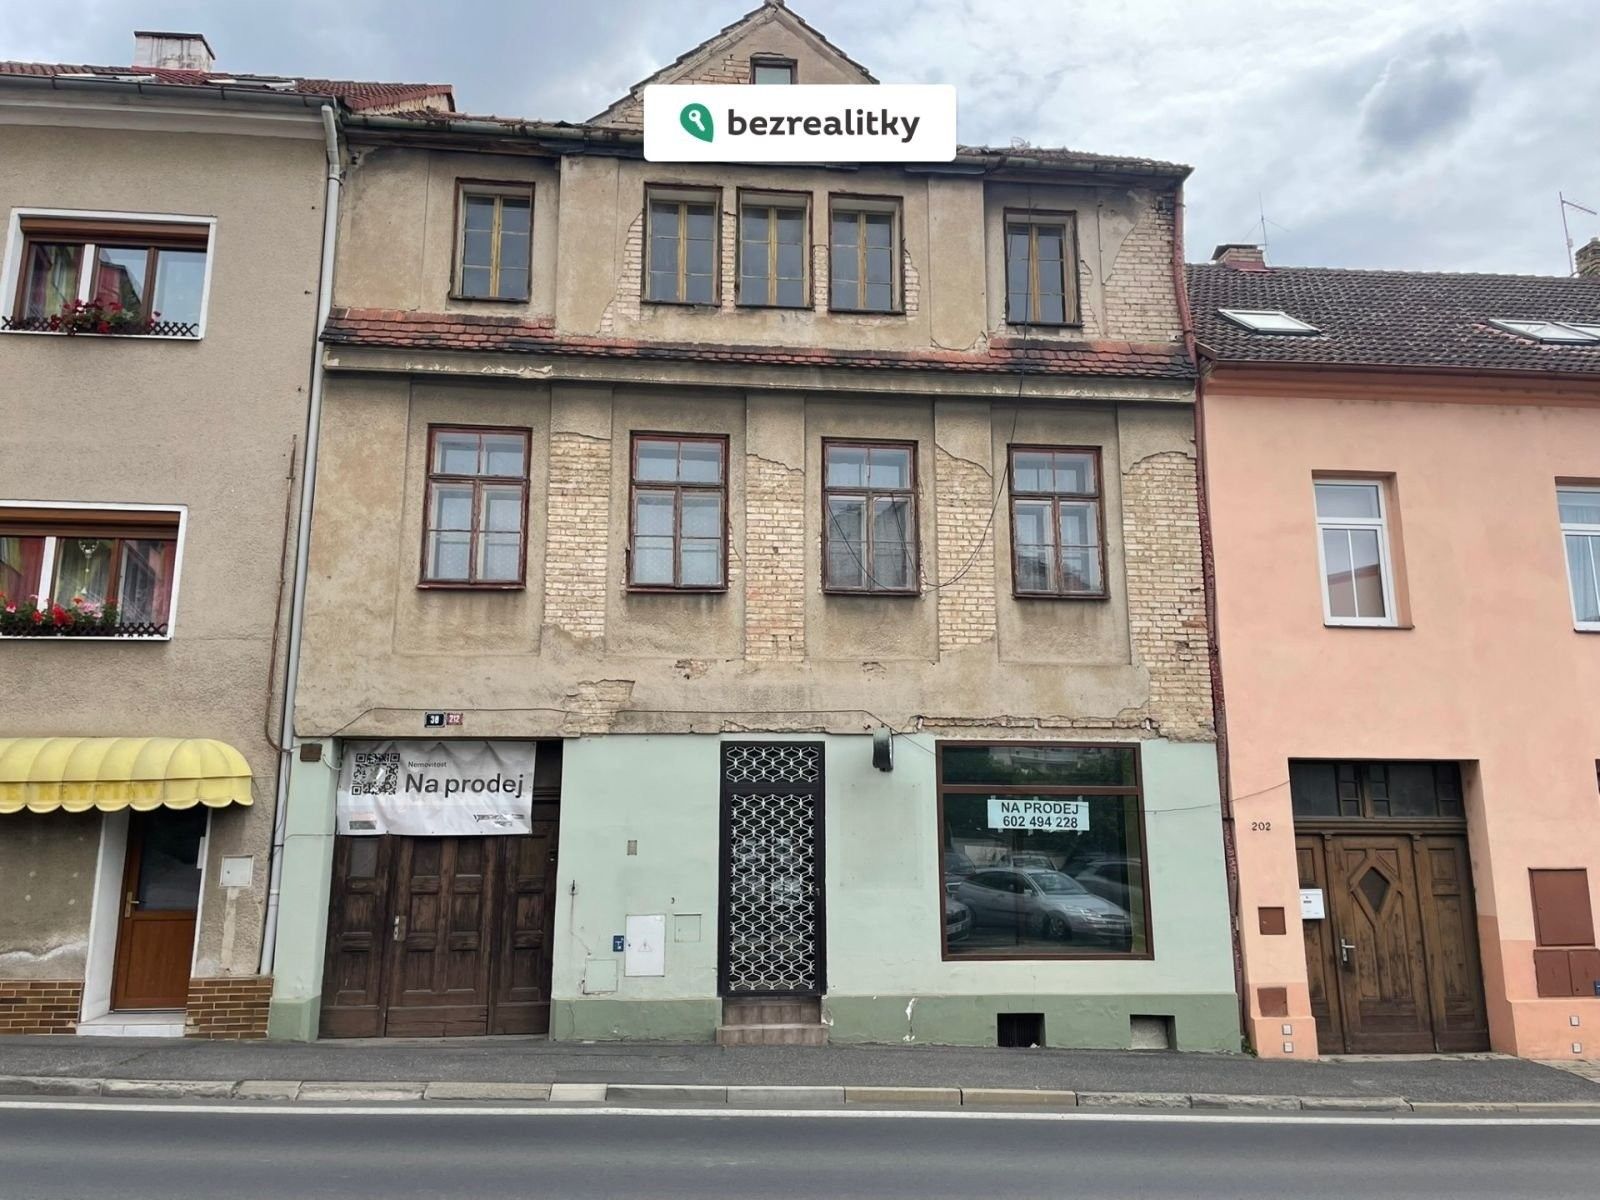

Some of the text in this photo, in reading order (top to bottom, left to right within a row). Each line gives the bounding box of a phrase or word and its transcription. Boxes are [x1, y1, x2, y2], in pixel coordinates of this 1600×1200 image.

[405, 773, 524, 798] Na prodej
[1001, 802, 1079, 815] NA PRODEJ
[1003, 815, 1078, 828] 602 494 228
[1251, 822, 1271, 831] 202
